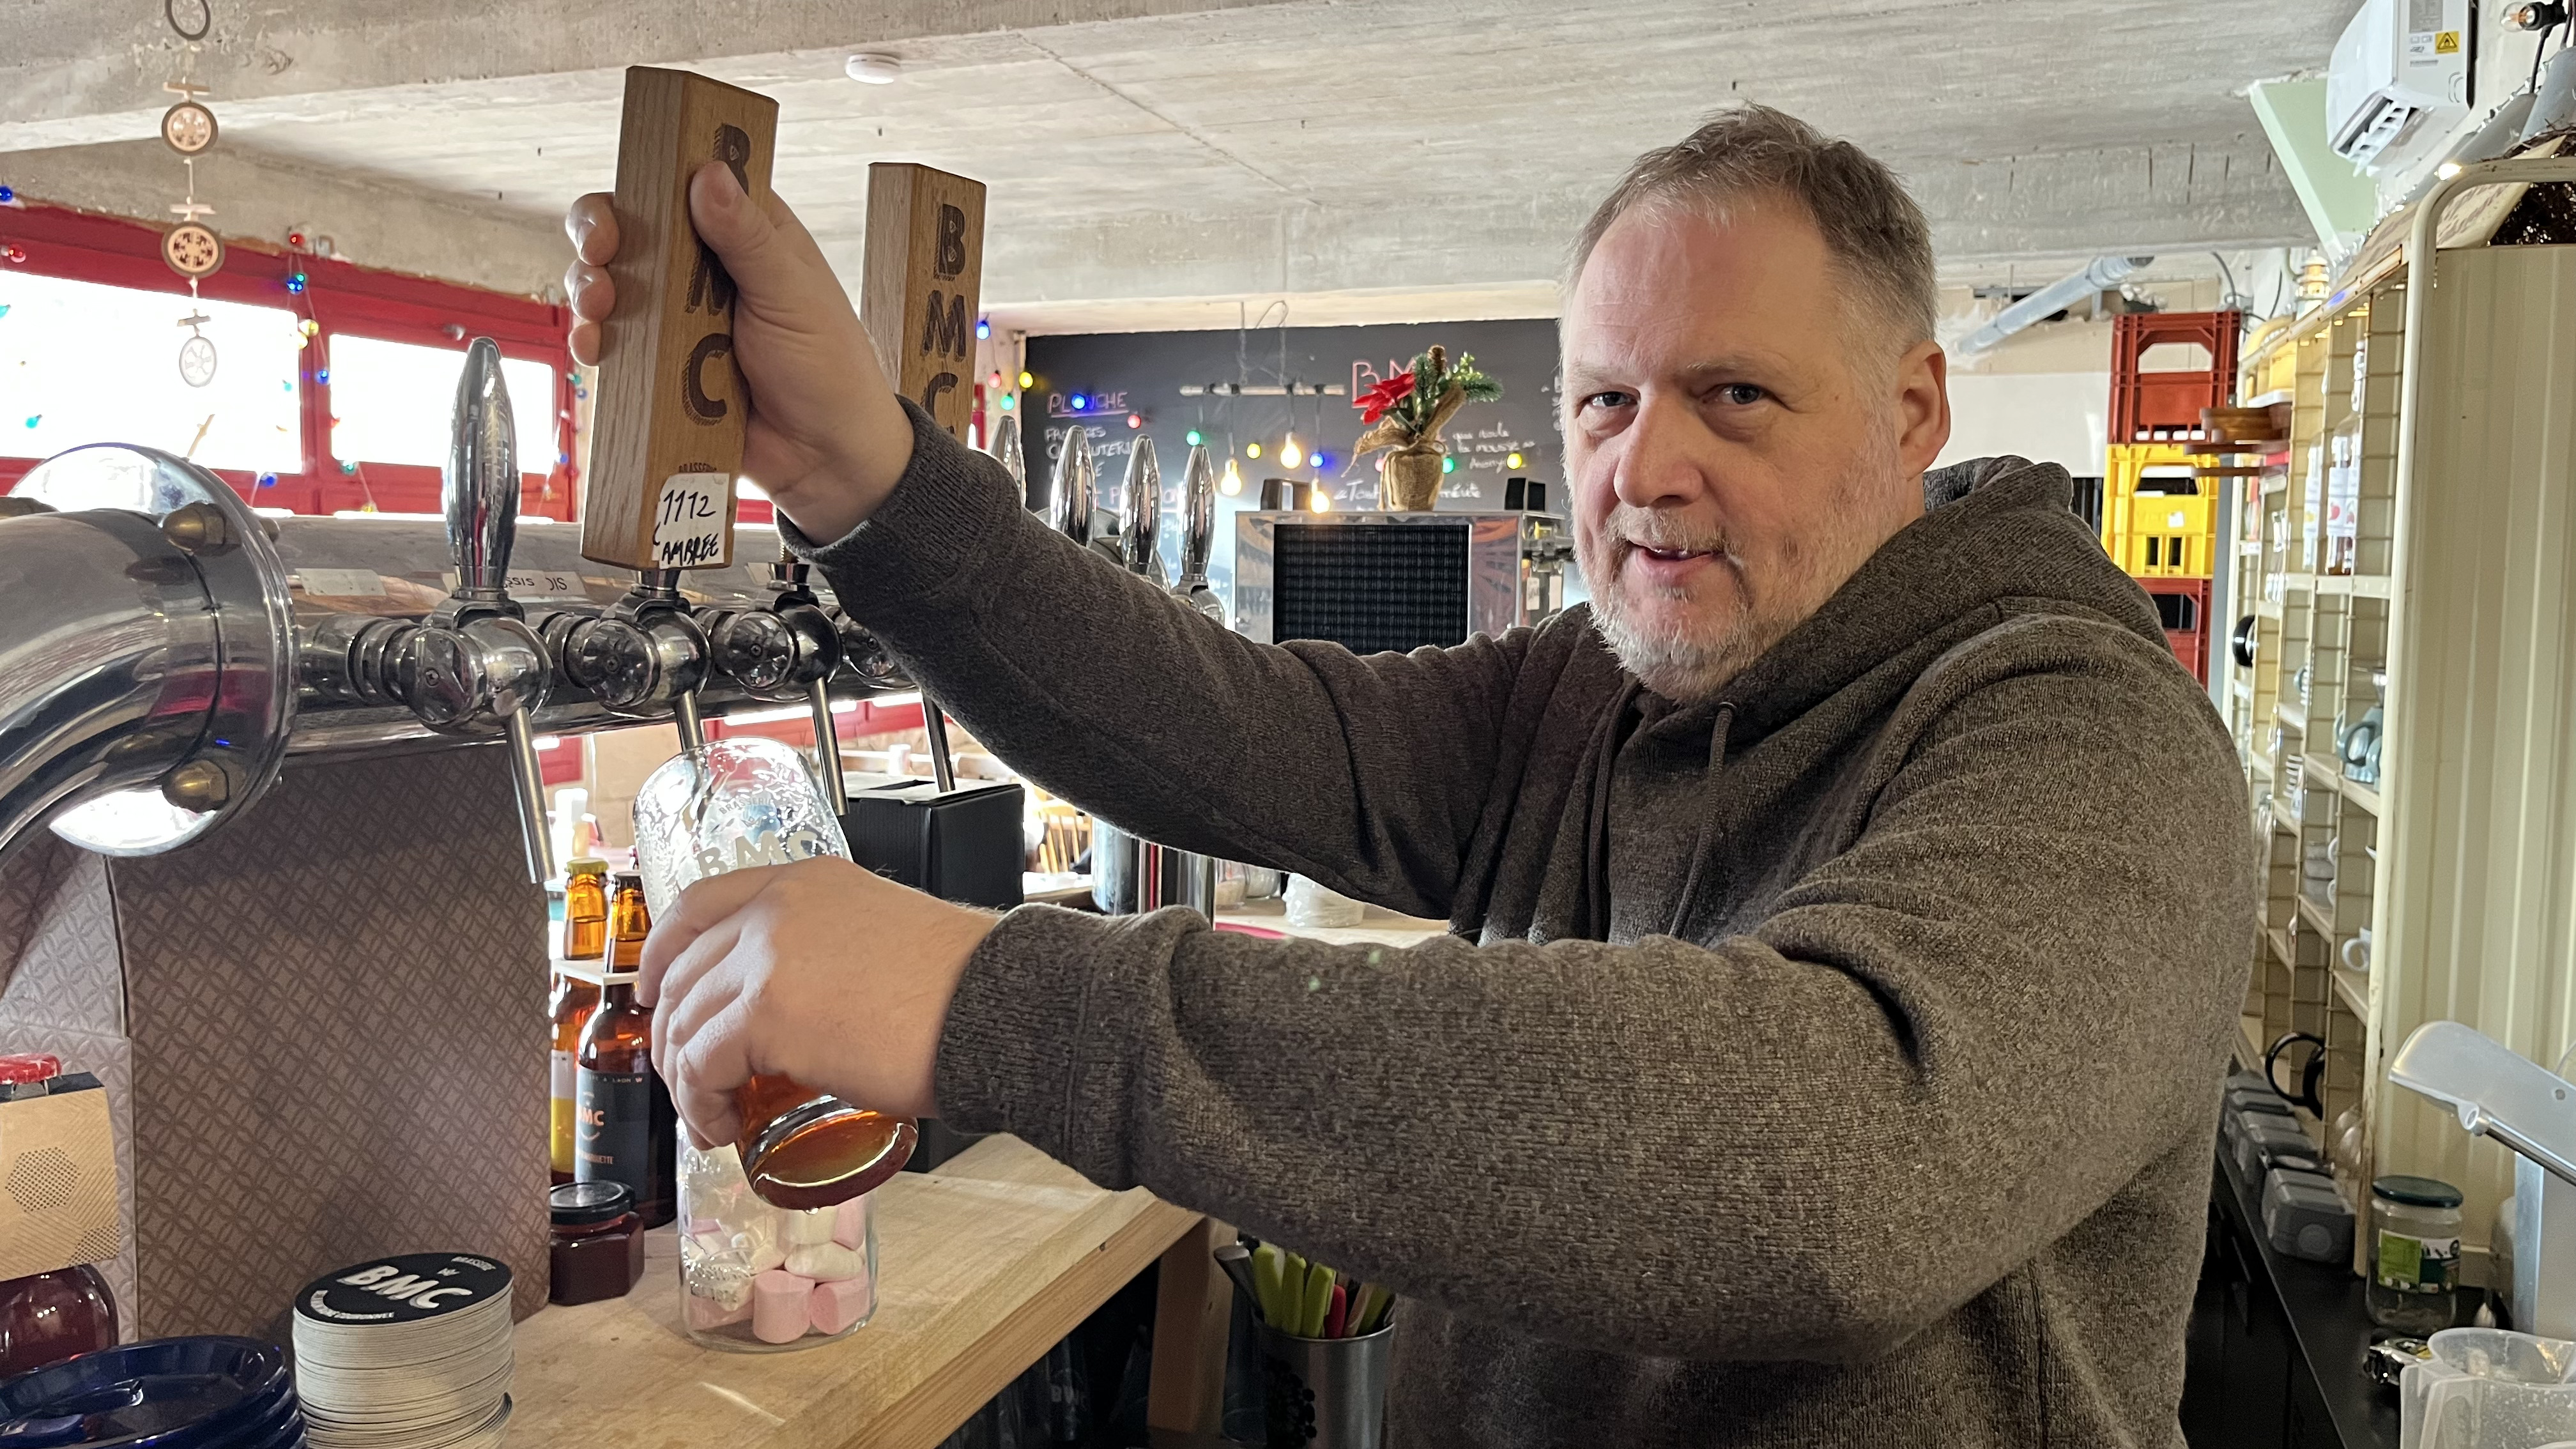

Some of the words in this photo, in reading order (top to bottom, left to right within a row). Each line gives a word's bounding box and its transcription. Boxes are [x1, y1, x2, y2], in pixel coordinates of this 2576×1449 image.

[1047, 392, 1128, 414] PLNCHE
[663, 489, 717, 525] 1112
[336, 1265, 473, 1309] BMC
